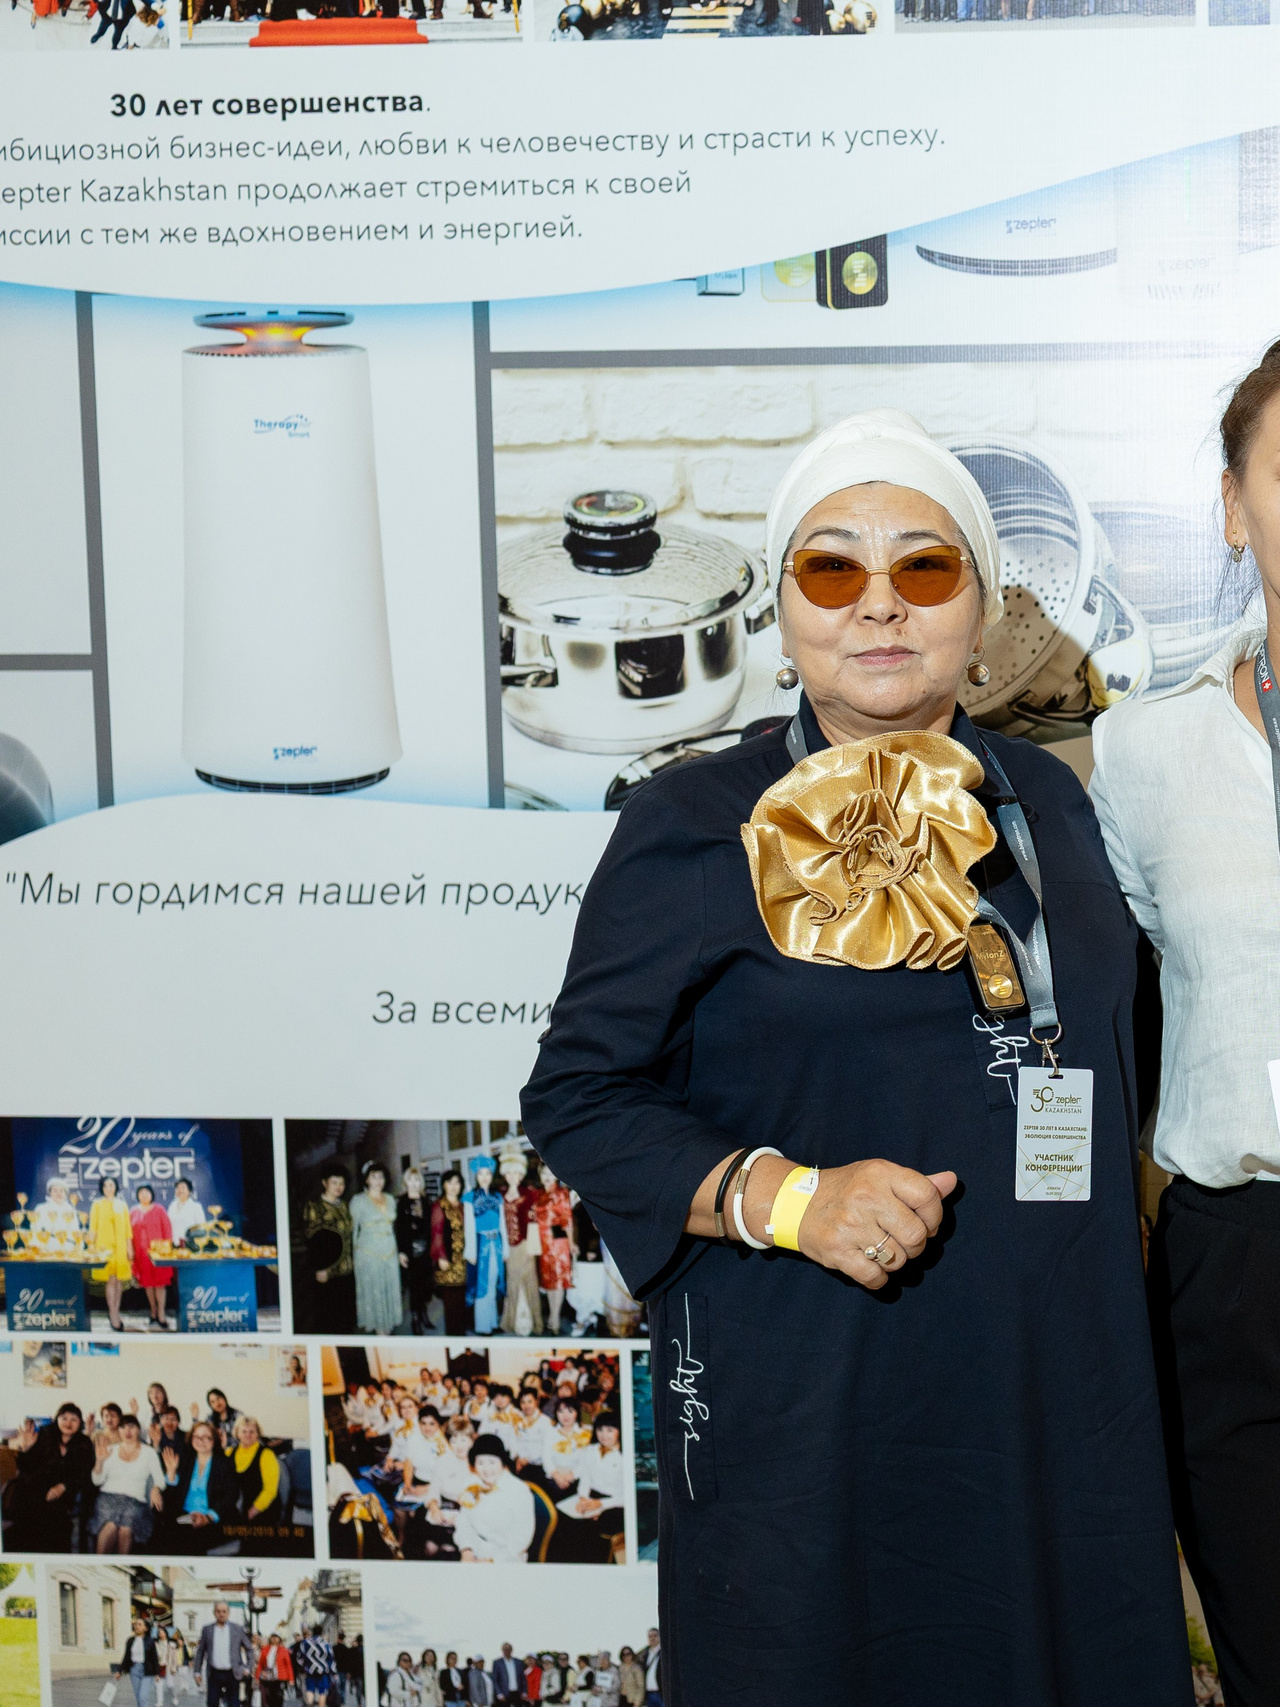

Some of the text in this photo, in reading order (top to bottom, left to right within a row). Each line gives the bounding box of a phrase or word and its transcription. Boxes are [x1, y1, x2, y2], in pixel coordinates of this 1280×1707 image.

[110, 94, 431, 121] 30 лет совершенства.
[170, 135, 351, 160] бизнес-идеи,
[359, 132, 447, 156] любви
[457, 138, 471, 154] к
[480, 134, 669, 157] человечеству
[679, 133, 694, 150] и
[704, 131, 811, 156] страсти
[821, 130, 836, 147] к
[844, 128, 946, 154] успеху.
[0, 170, 691, 210] epter Kazakhstan продолжает стремиться к своей
[80, 228, 94, 245] с
[101, 228, 150, 244] тем
[159, 227, 198, 244] же
[208, 224, 409, 247] вдохновением
[419, 223, 434, 240] и
[443, 214, 583, 245] энергией.
[6, 872, 80, 905] "Мы
[95, 882, 284, 914] гордимся
[299, 873, 427, 905] нашей
[372, 990, 417, 1024] За
[1045, 1106, 1082, 1114] KAZAKHSTAN
[59, 1116, 136, 1155] 20
[77, 1147, 196, 1188] zepter
[1025, 1163, 1083, 1173] КОНФЕРЕНЦИИ
[1034, 1153, 1074, 1162] УЧАСТНИК
